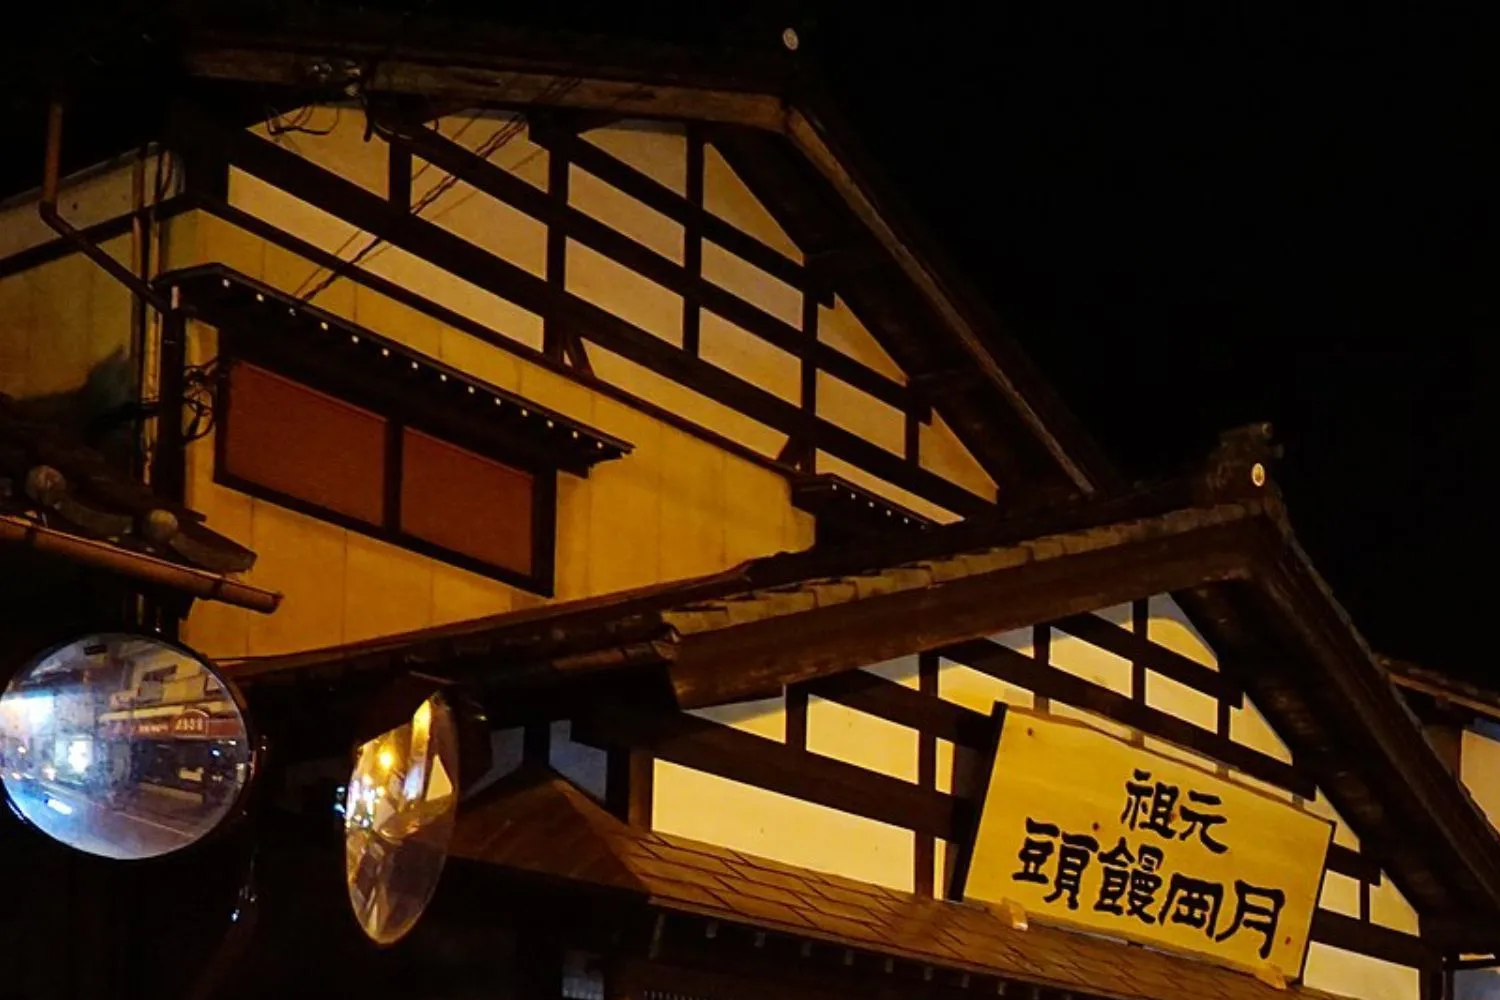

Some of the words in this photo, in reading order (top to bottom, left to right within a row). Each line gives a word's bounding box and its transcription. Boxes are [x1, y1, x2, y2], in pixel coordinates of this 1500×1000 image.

[1120, 768, 1228, 854] 元祖
[1012, 816, 1286, 959] 月岡饅頭
